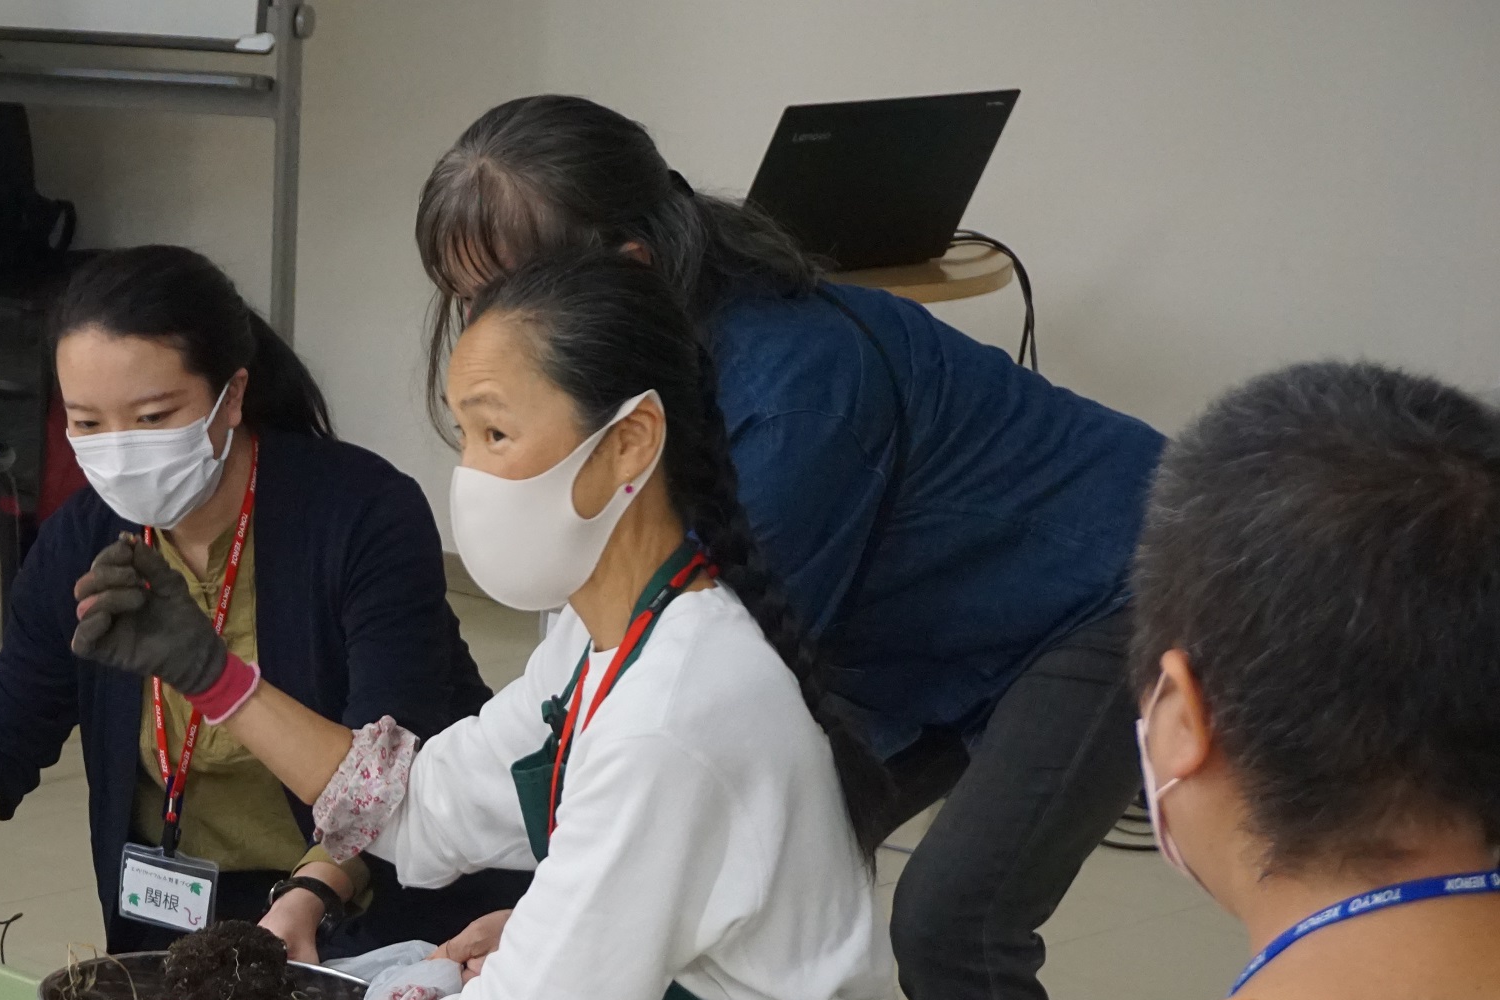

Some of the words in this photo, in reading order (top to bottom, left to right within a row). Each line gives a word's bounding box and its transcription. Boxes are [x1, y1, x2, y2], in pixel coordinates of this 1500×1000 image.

[237, 512, 248, 538] TOKYO
[231, 541, 241, 566] XEROX
[221, 584, 231, 609] TOKYO
[187, 724, 197, 747] TOKYO
[181, 750, 190, 774] XEROX
[1443, 875, 1486, 890] XEROX
[145, 886, 179, 912] 関根
[1348, 888, 1401, 913] TOKYO
[1293, 904, 1342, 935] XEROX
